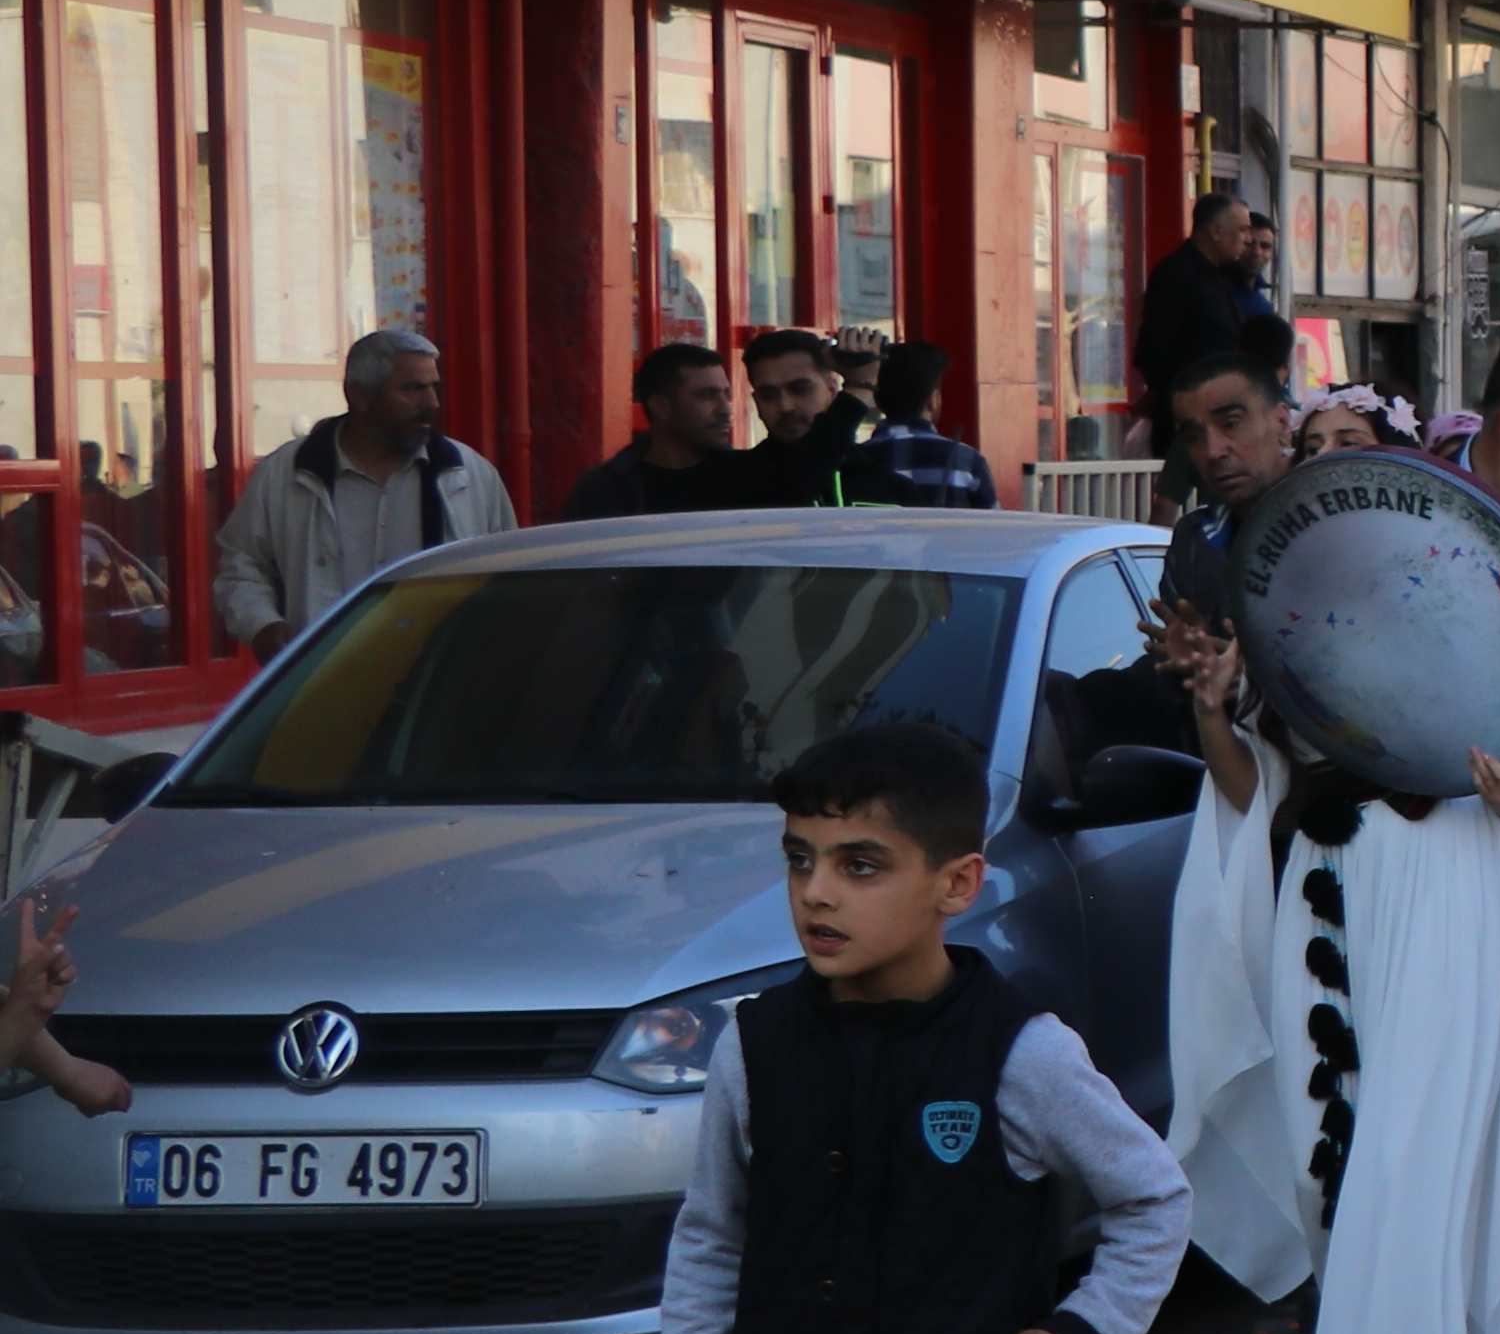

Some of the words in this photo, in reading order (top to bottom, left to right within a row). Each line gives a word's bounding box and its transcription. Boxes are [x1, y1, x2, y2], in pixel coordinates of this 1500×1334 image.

[1245, 502, 1321, 598] EL-RUHA
[1316, 485, 1435, 521] ERBANE
[930, 1122, 974, 1134] TEAM
[134, 1177, 157, 1194] TR
[162, 1143, 223, 1199] 06
[258, 1143, 320, 1198] FG
[346, 1142, 470, 1198] 4973
